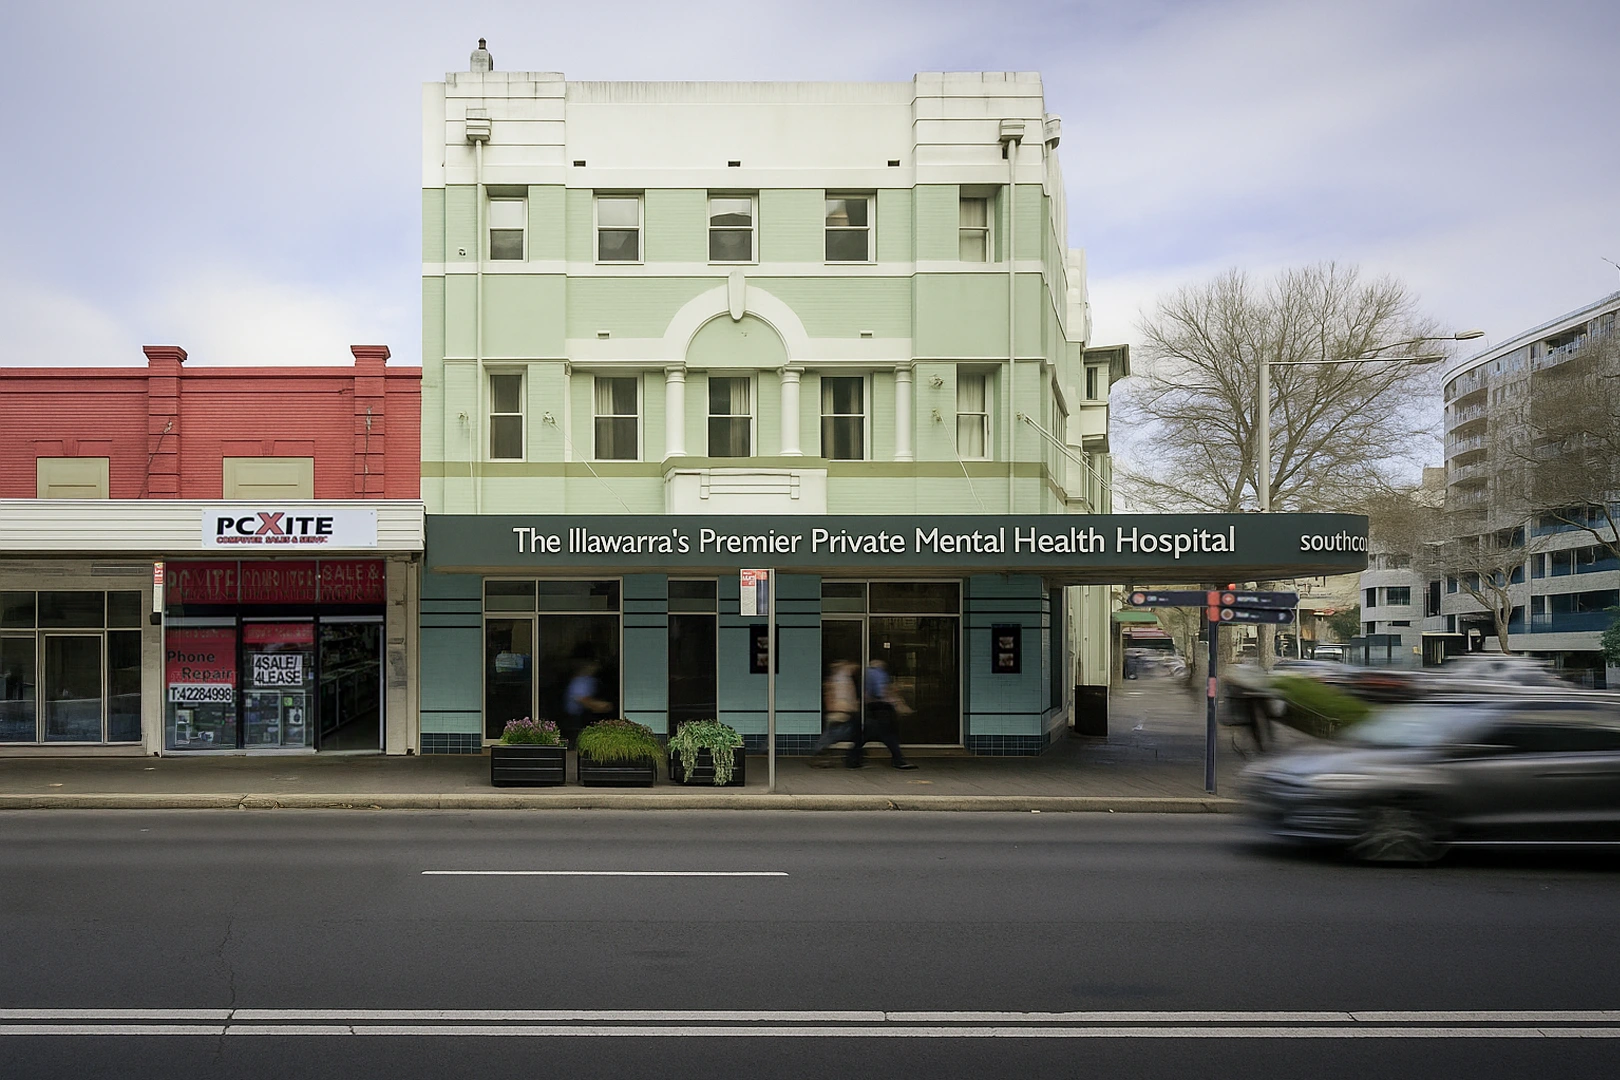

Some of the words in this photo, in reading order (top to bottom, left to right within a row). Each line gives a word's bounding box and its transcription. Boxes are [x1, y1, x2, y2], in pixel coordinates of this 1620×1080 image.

[216, 512, 334, 535] PCXITE
[512, 527, 561, 553] The
[569, 527, 690, 553] Illawarra's
[699, 528, 802, 553] Premier
[811, 527, 906, 553] Private
[915, 527, 1005, 553] Mental
[1014, 526, 1106, 553] Health
[1116, 526, 1236, 559] Hospital
[167, 651, 215, 663] Phone
[255, 656, 298, 670] 4SALE/
[181, 666, 232, 682] Repair
[255, 671, 301, 684] 4LEASE
[170, 687, 232, 701] T:42284998
